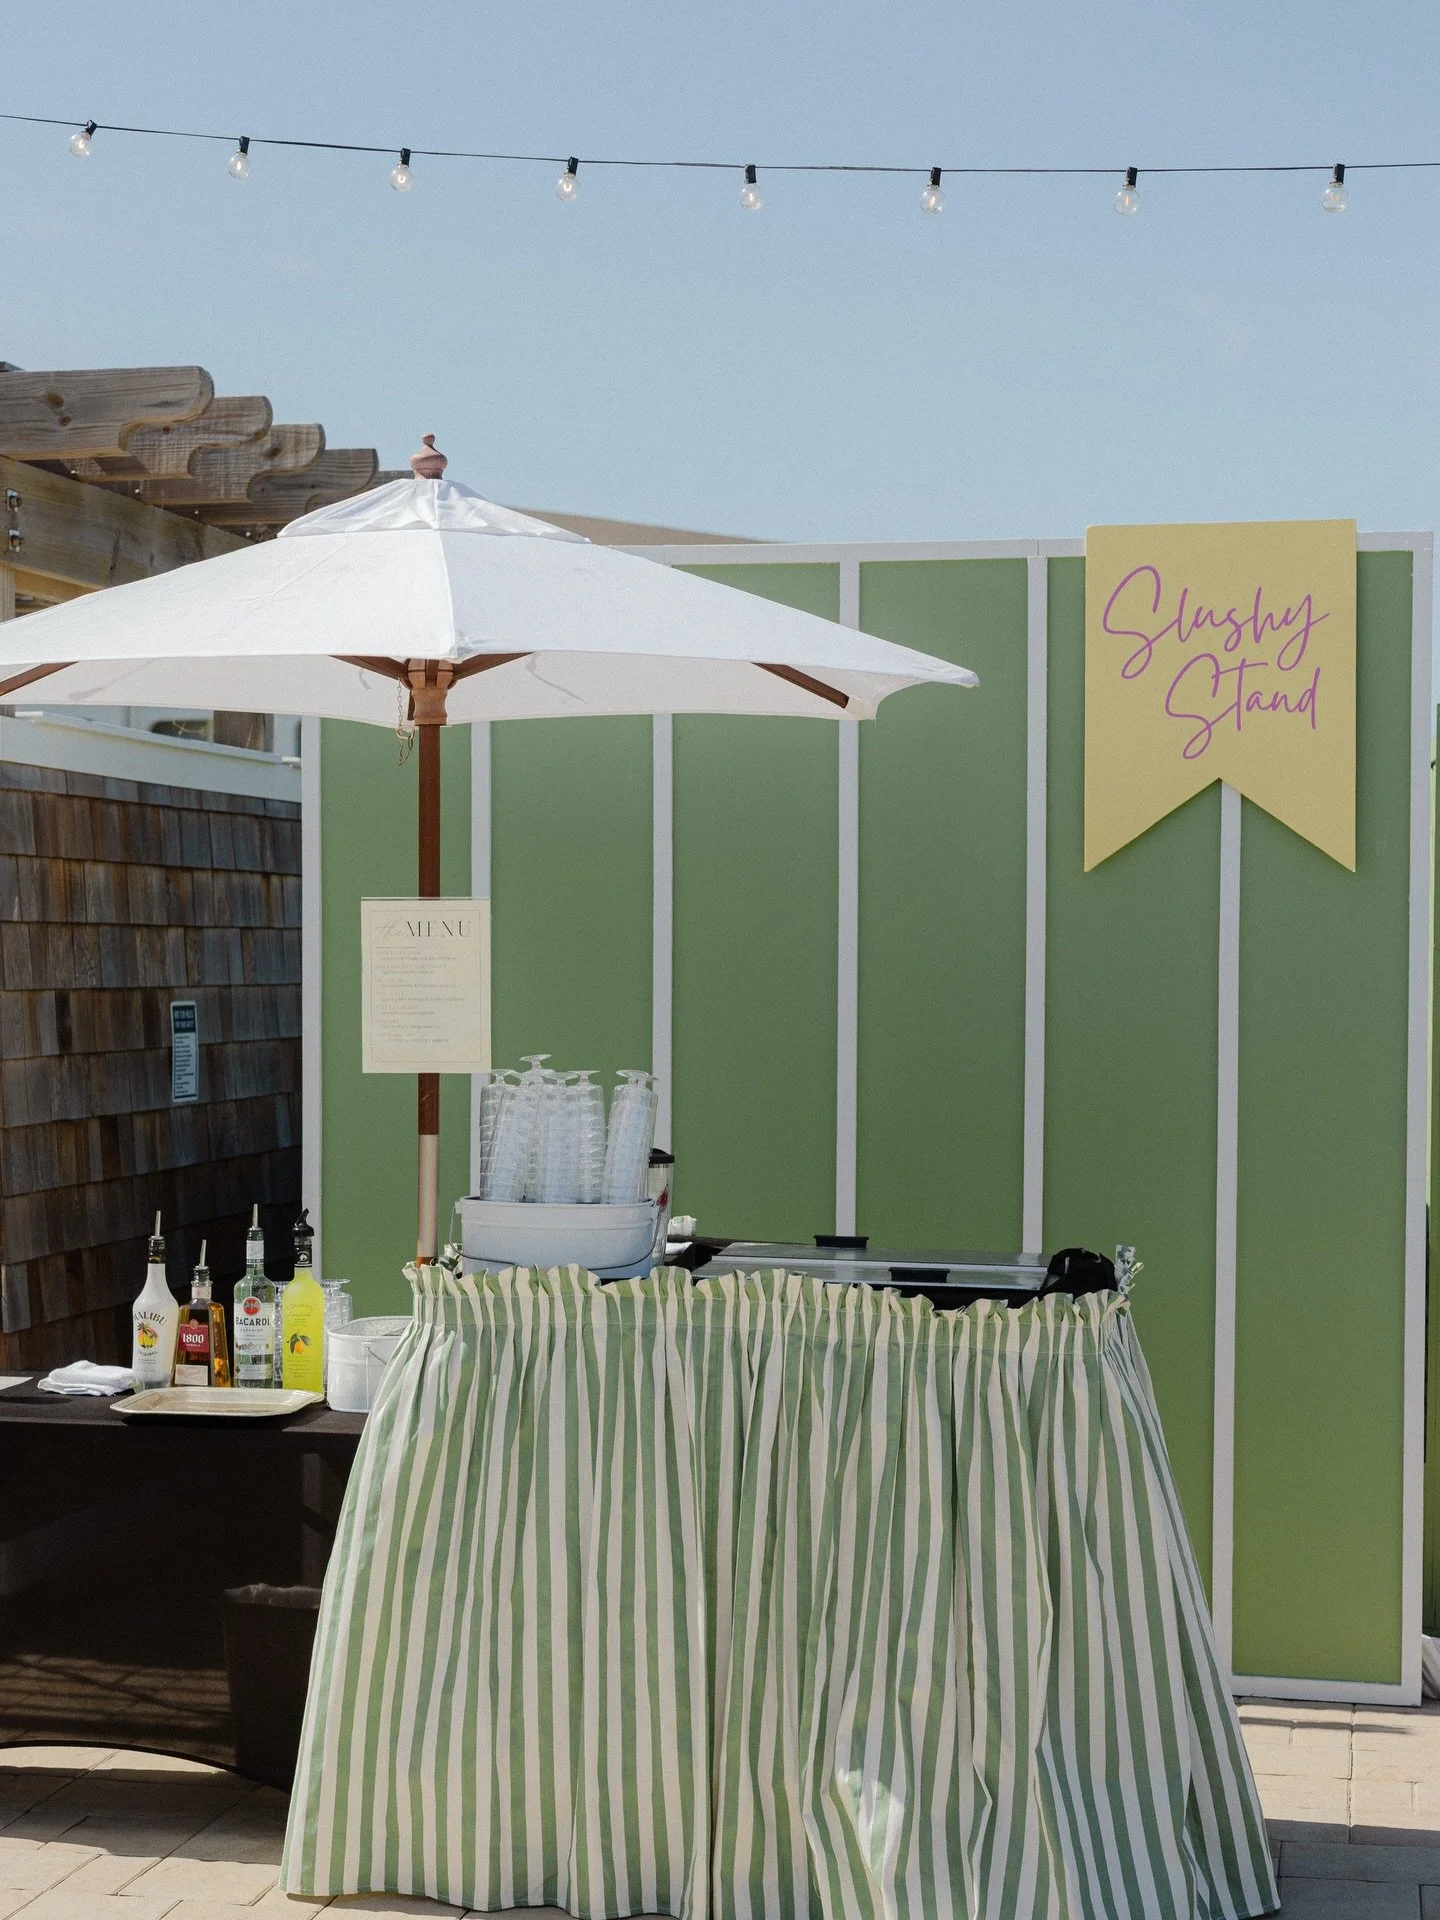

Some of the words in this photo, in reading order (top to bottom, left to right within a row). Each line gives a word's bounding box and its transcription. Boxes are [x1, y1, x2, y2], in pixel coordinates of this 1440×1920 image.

[1102, 565, 1331, 679] Slushy
[1165, 652, 1321, 760] Stand
[406, 920, 472, 938] MENU
[133, 1311, 167, 1326] MALIBU
[182, 1333, 205, 1344] 1800
